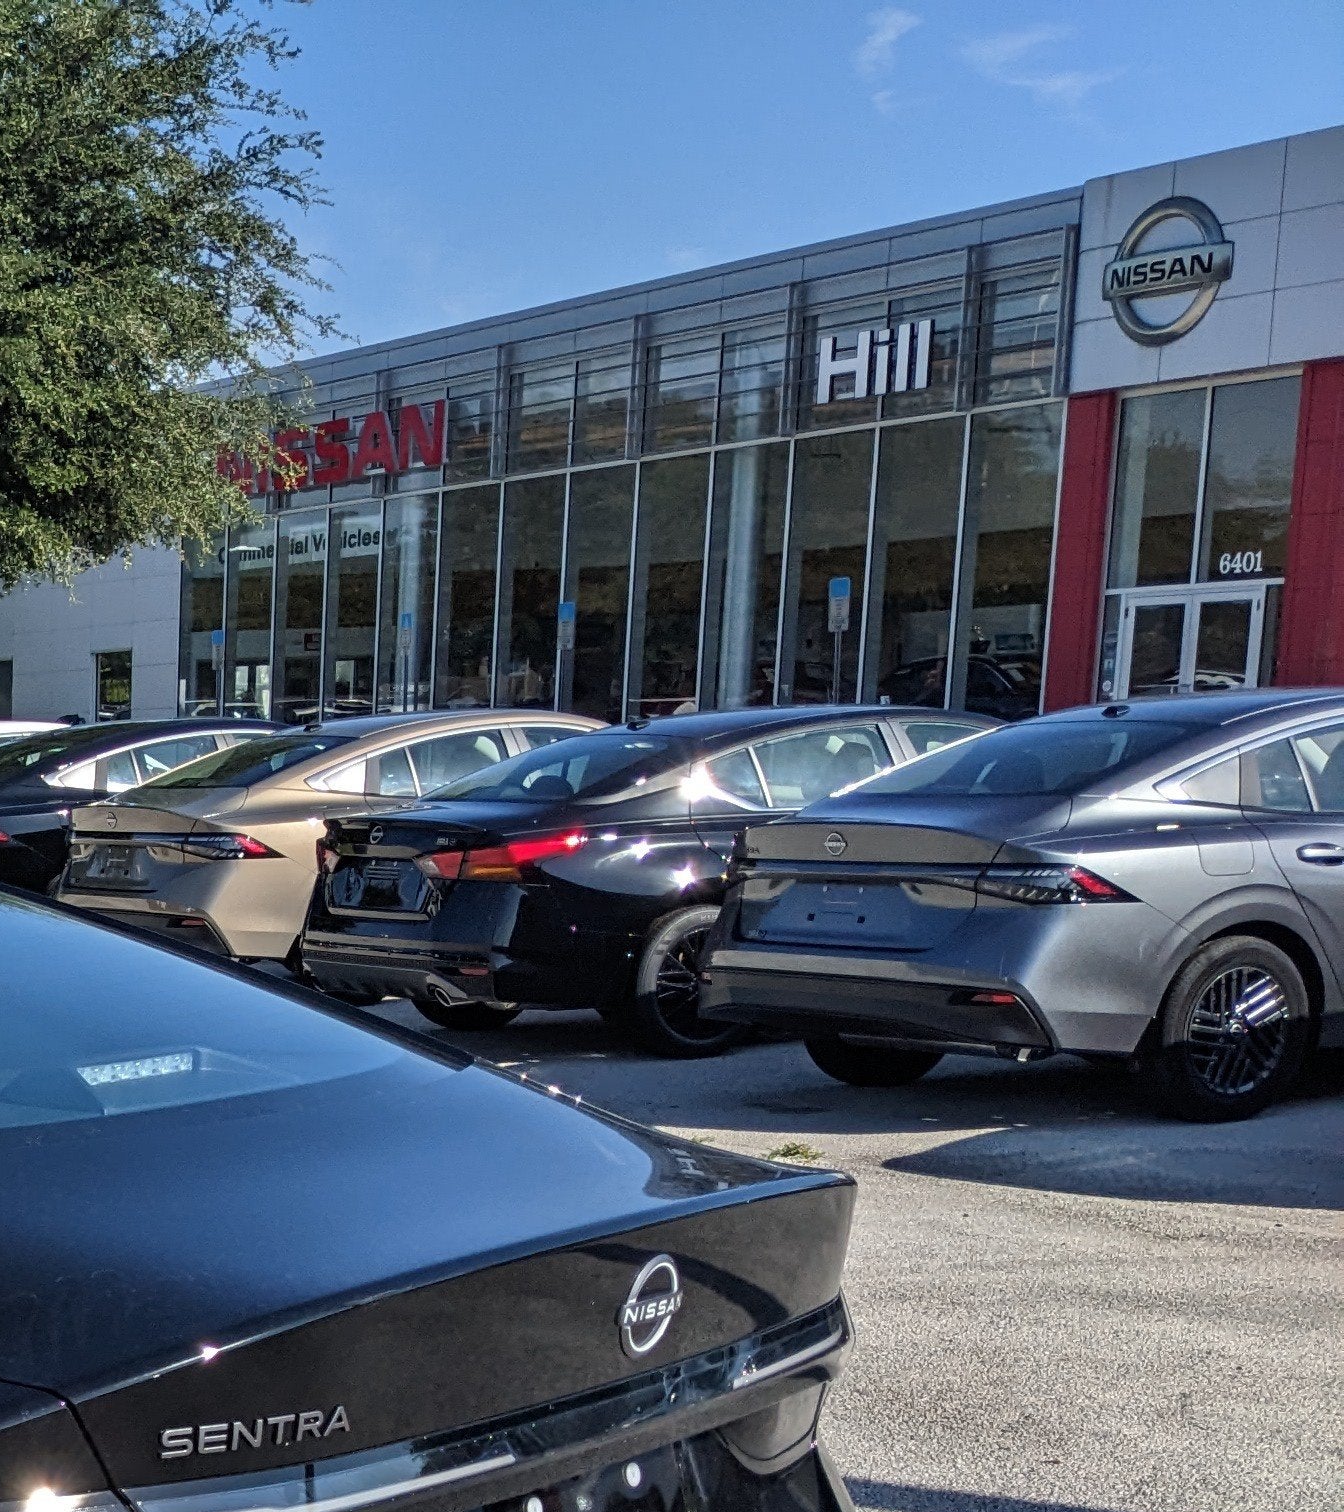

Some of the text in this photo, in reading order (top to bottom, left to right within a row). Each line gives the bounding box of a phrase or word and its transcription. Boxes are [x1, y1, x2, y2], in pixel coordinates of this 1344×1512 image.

[1110, 251, 1214, 290] NISSAN
[817, 319, 935, 404] Hill
[1218, 551, 1263, 575] 6401
[160, 1404, 352, 1460] SENTRA
